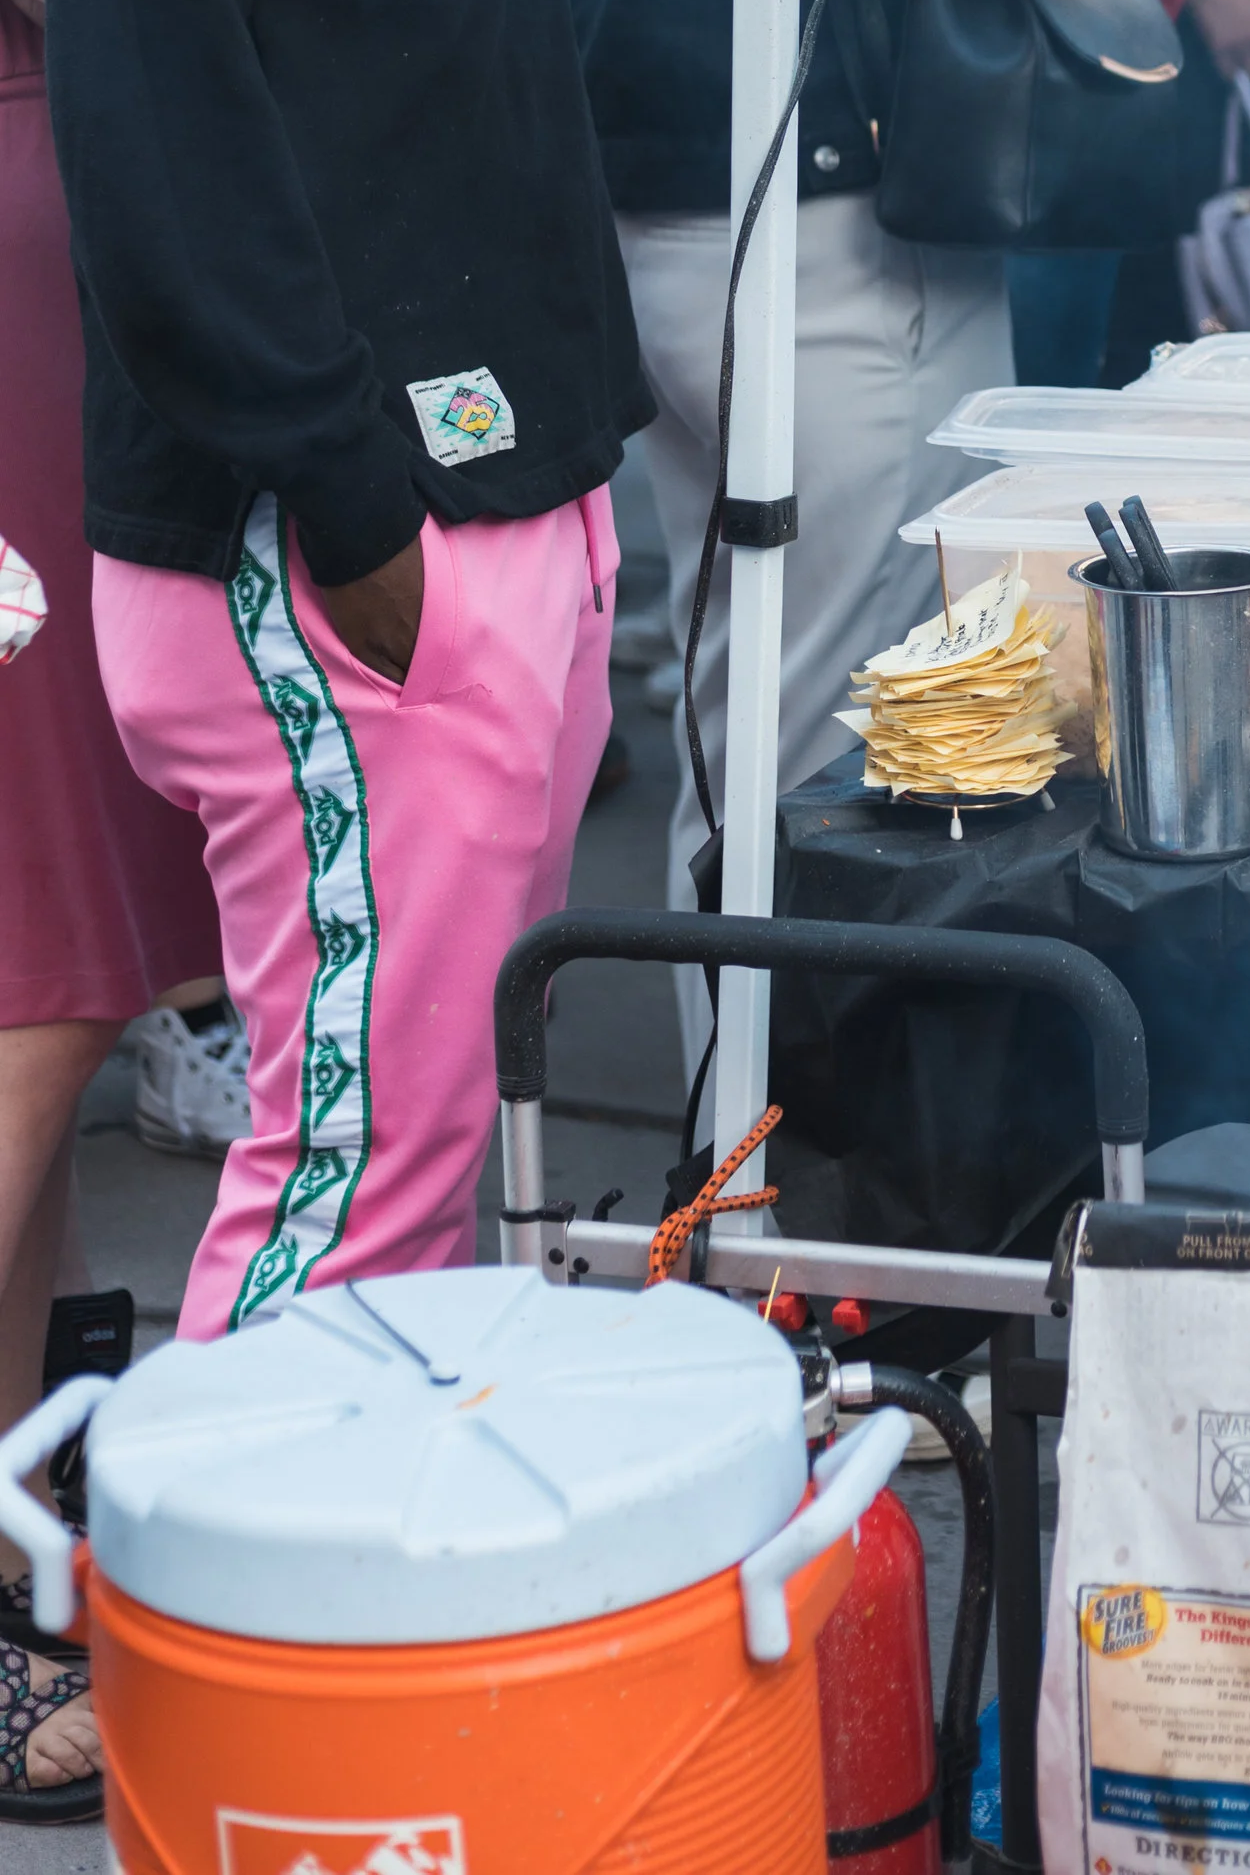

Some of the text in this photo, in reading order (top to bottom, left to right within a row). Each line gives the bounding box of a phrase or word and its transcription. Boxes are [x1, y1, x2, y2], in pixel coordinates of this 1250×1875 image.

[273, 674, 311, 733] PONY
[312, 785, 338, 848] PONY
[313, 1031, 338, 1098] PONY
[1177, 1247, 1196, 1259] ON
[1199, 1247, 1240, 1260] FRONT
[1182, 1235, 1213, 1248] PULL
[254, 1235, 297, 1292] PONY
[1094, 1591, 1143, 1623] SURE
[1175, 1608, 1206, 1624] The
[1104, 1612, 1146, 1642] FIRE
[1103, 1782, 1152, 1805] Looking
[1174, 1794, 1200, 1809] tips
[1202, 1798, 1219, 1809] on
[1221, 1797, 1250, 1812] how
